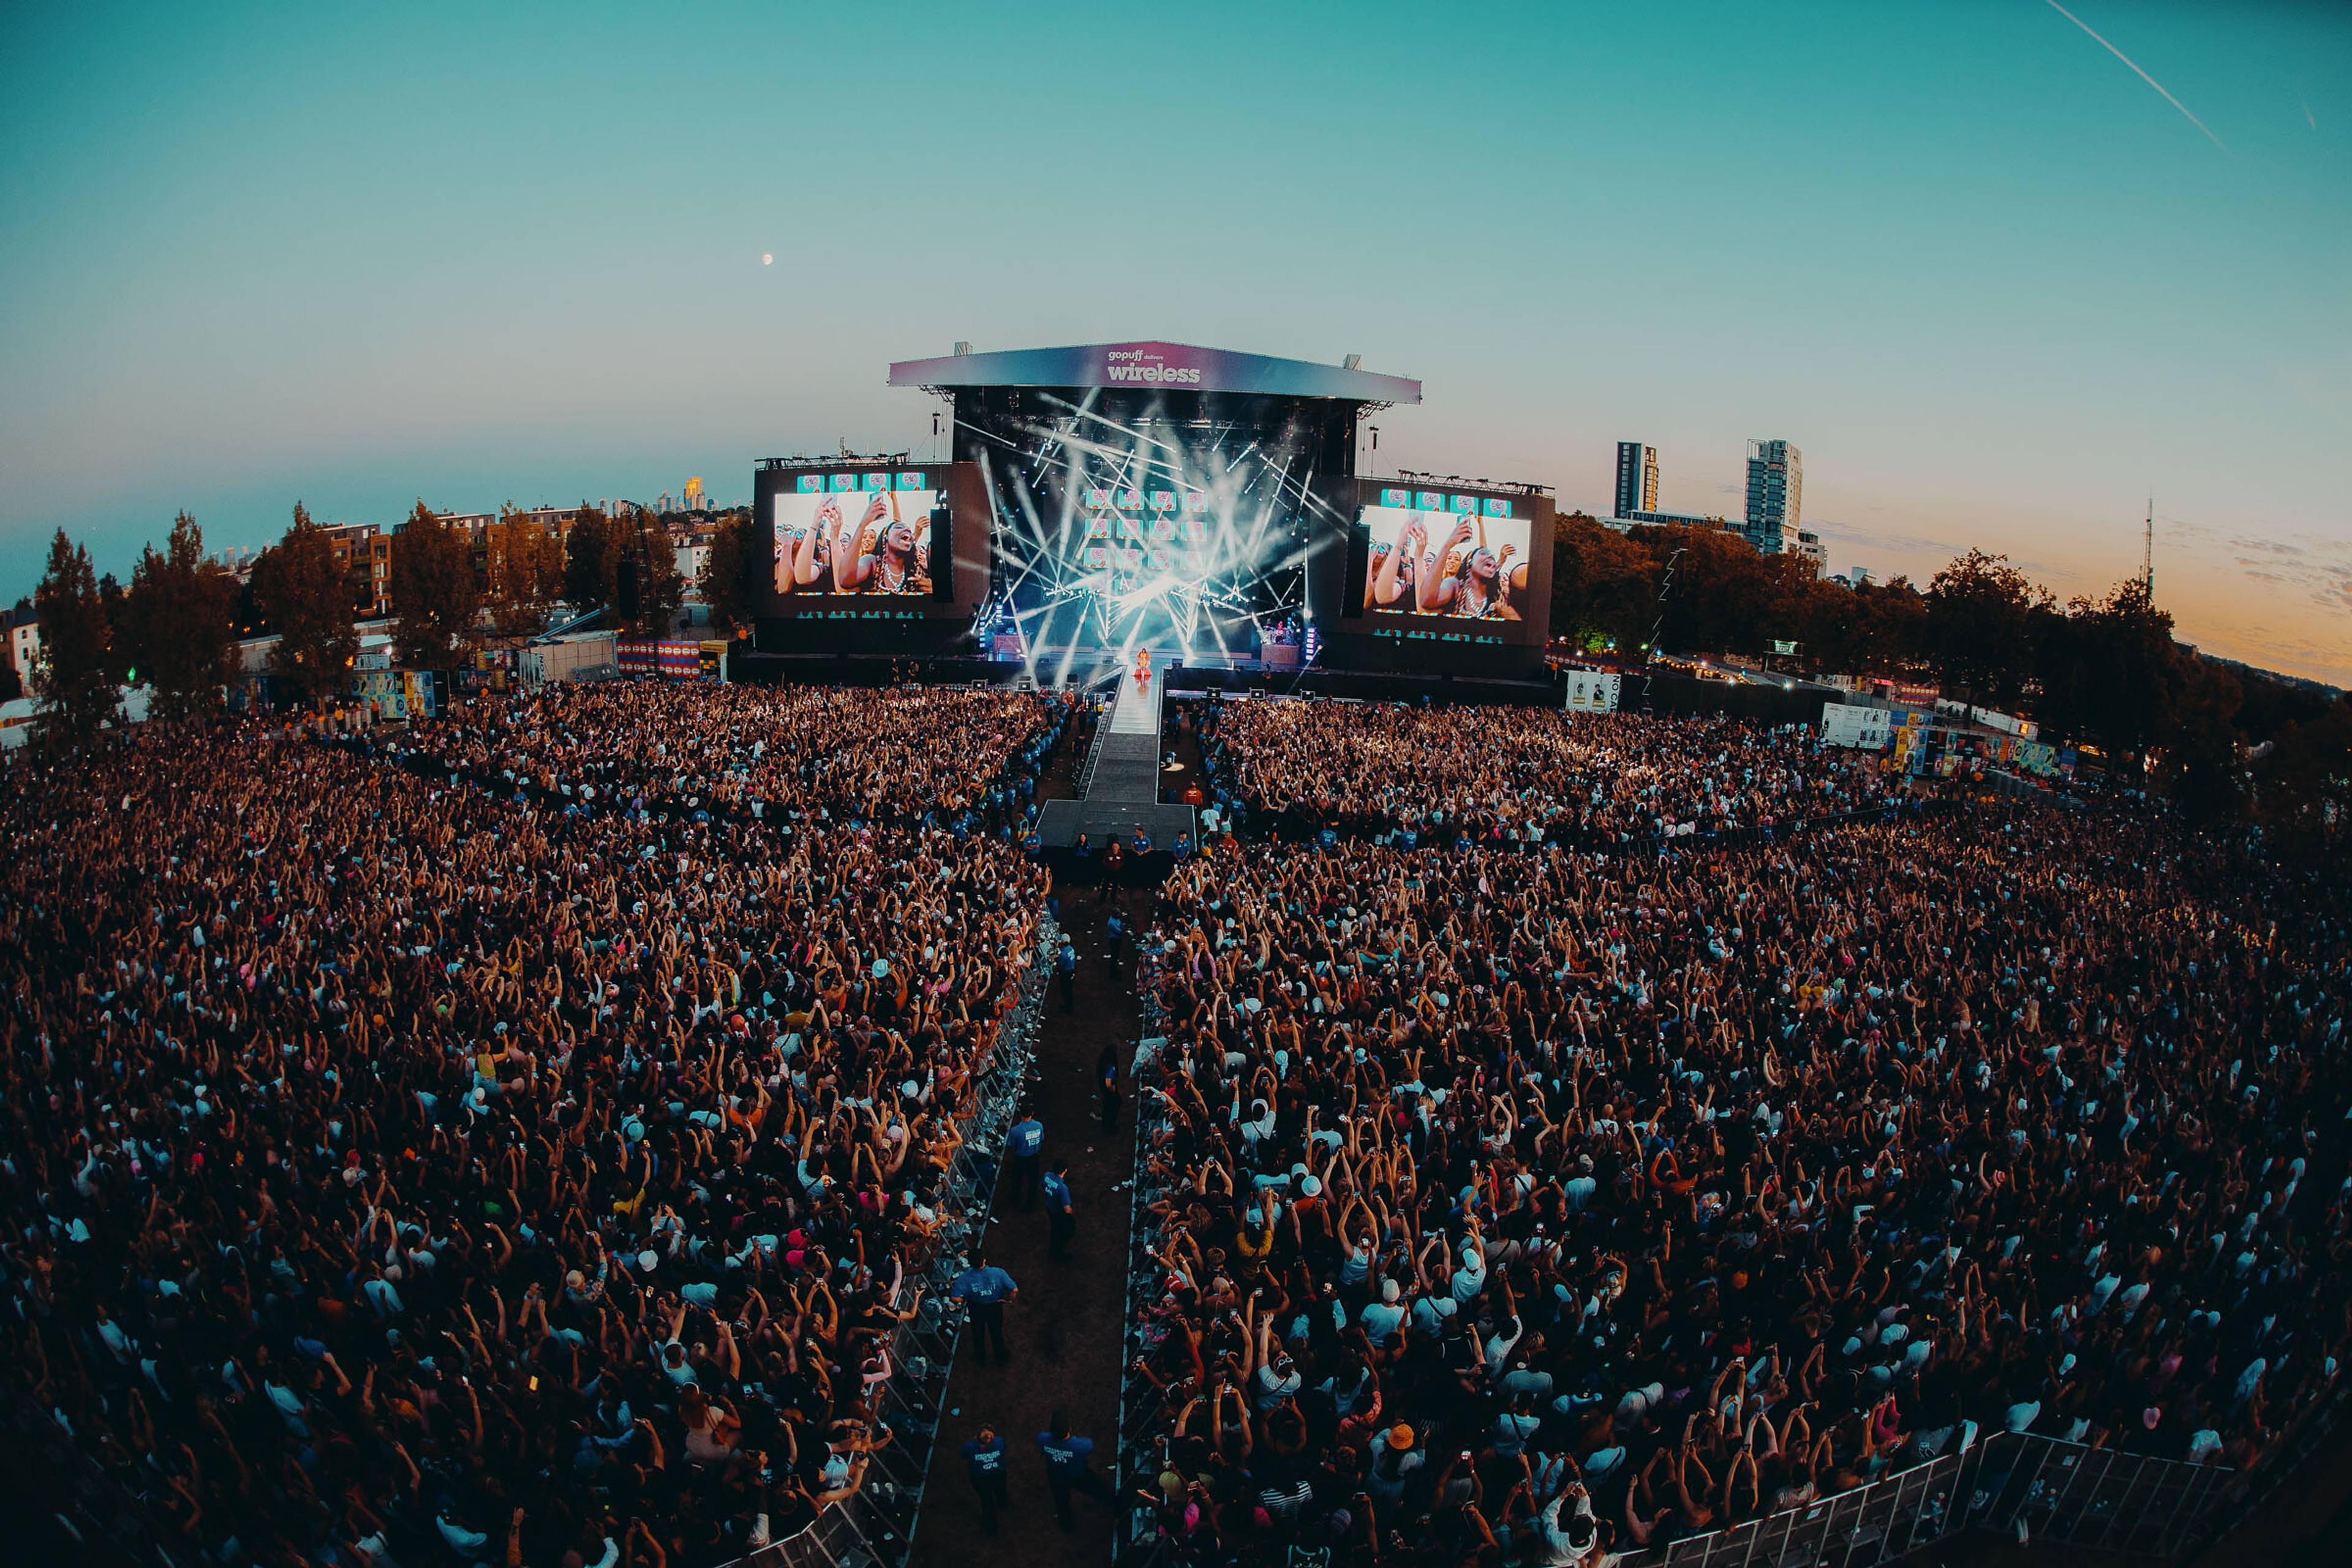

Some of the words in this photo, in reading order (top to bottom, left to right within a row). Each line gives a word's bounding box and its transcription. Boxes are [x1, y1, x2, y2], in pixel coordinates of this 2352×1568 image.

[1108, 350, 1144, 361] gopuff
[1107, 363, 1200, 383] wireless
[1611, 675, 1620, 691] NO
